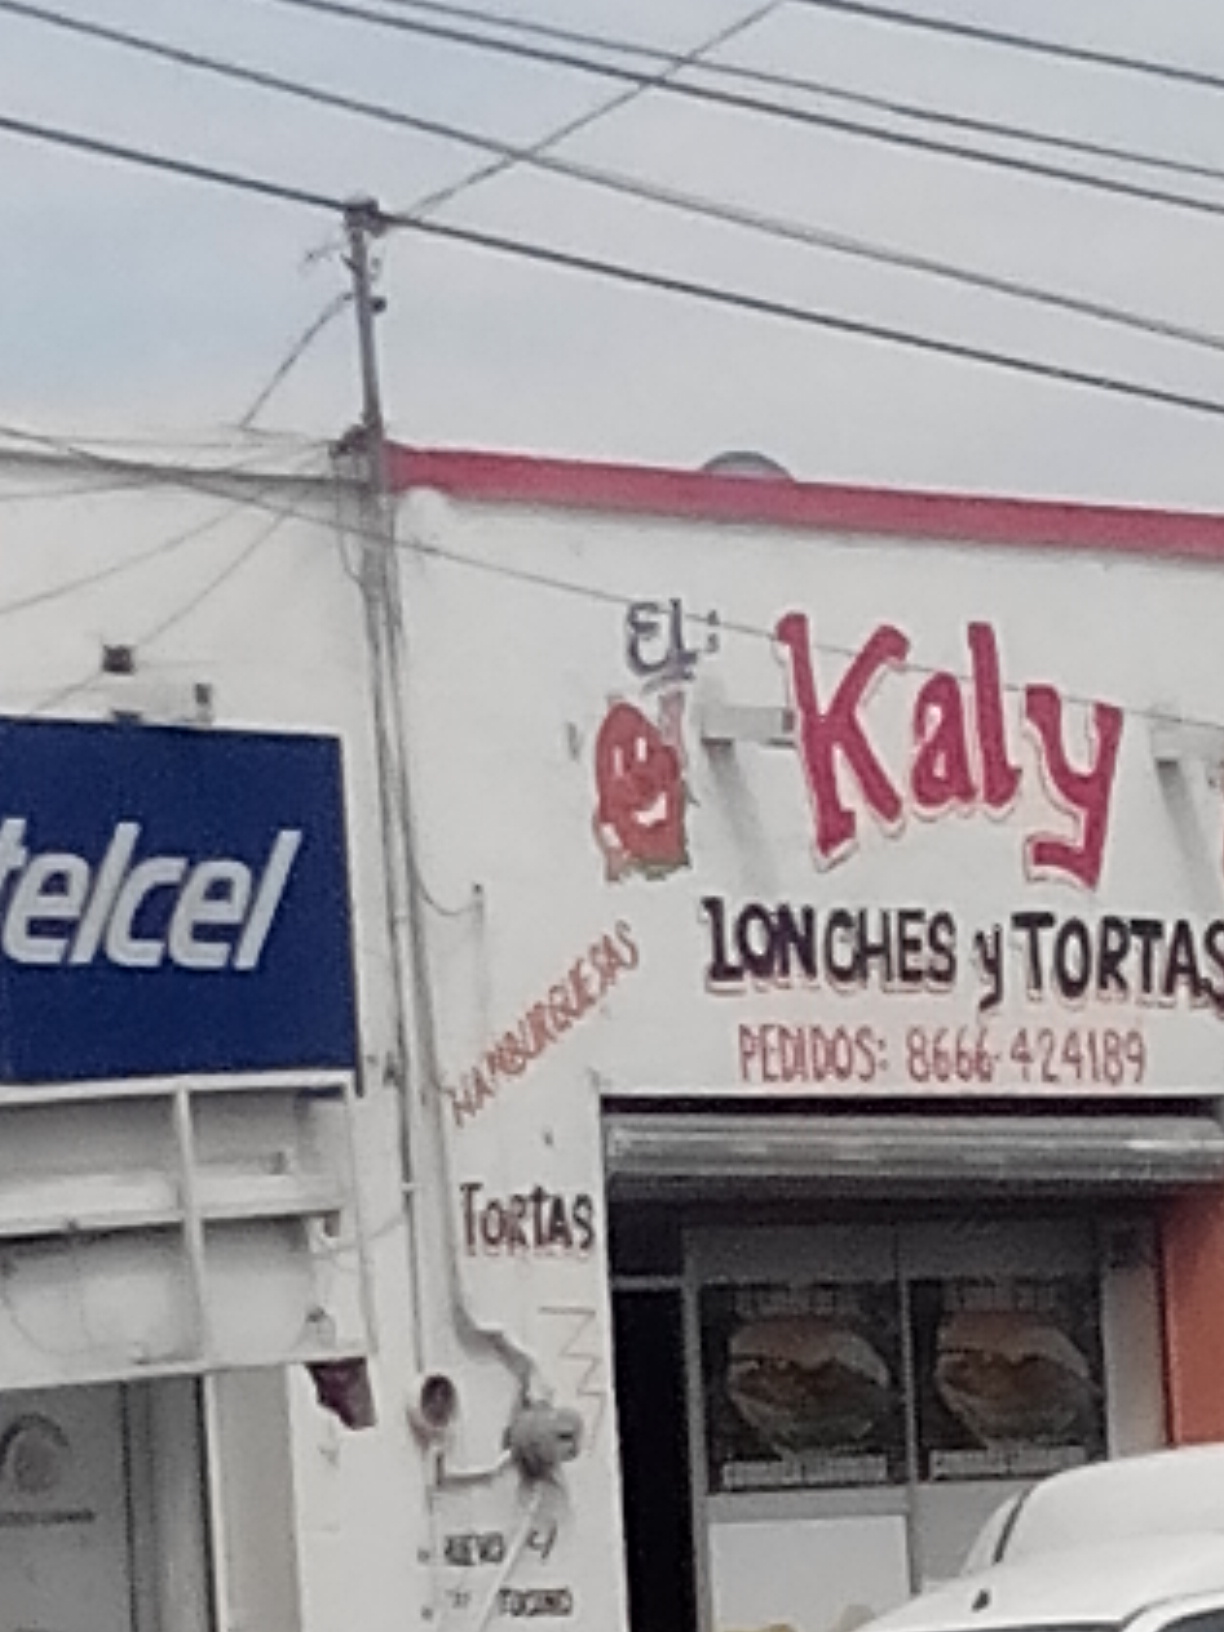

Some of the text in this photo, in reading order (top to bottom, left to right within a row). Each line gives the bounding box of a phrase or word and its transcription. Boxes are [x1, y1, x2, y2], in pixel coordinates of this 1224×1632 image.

[776, 612, 1124, 890] Kaly
[702, 897, 957, 985] LONCHES
[975, 924, 1004, 1012] y
[738, 1023, 890, 1083] PEDIDOS:
